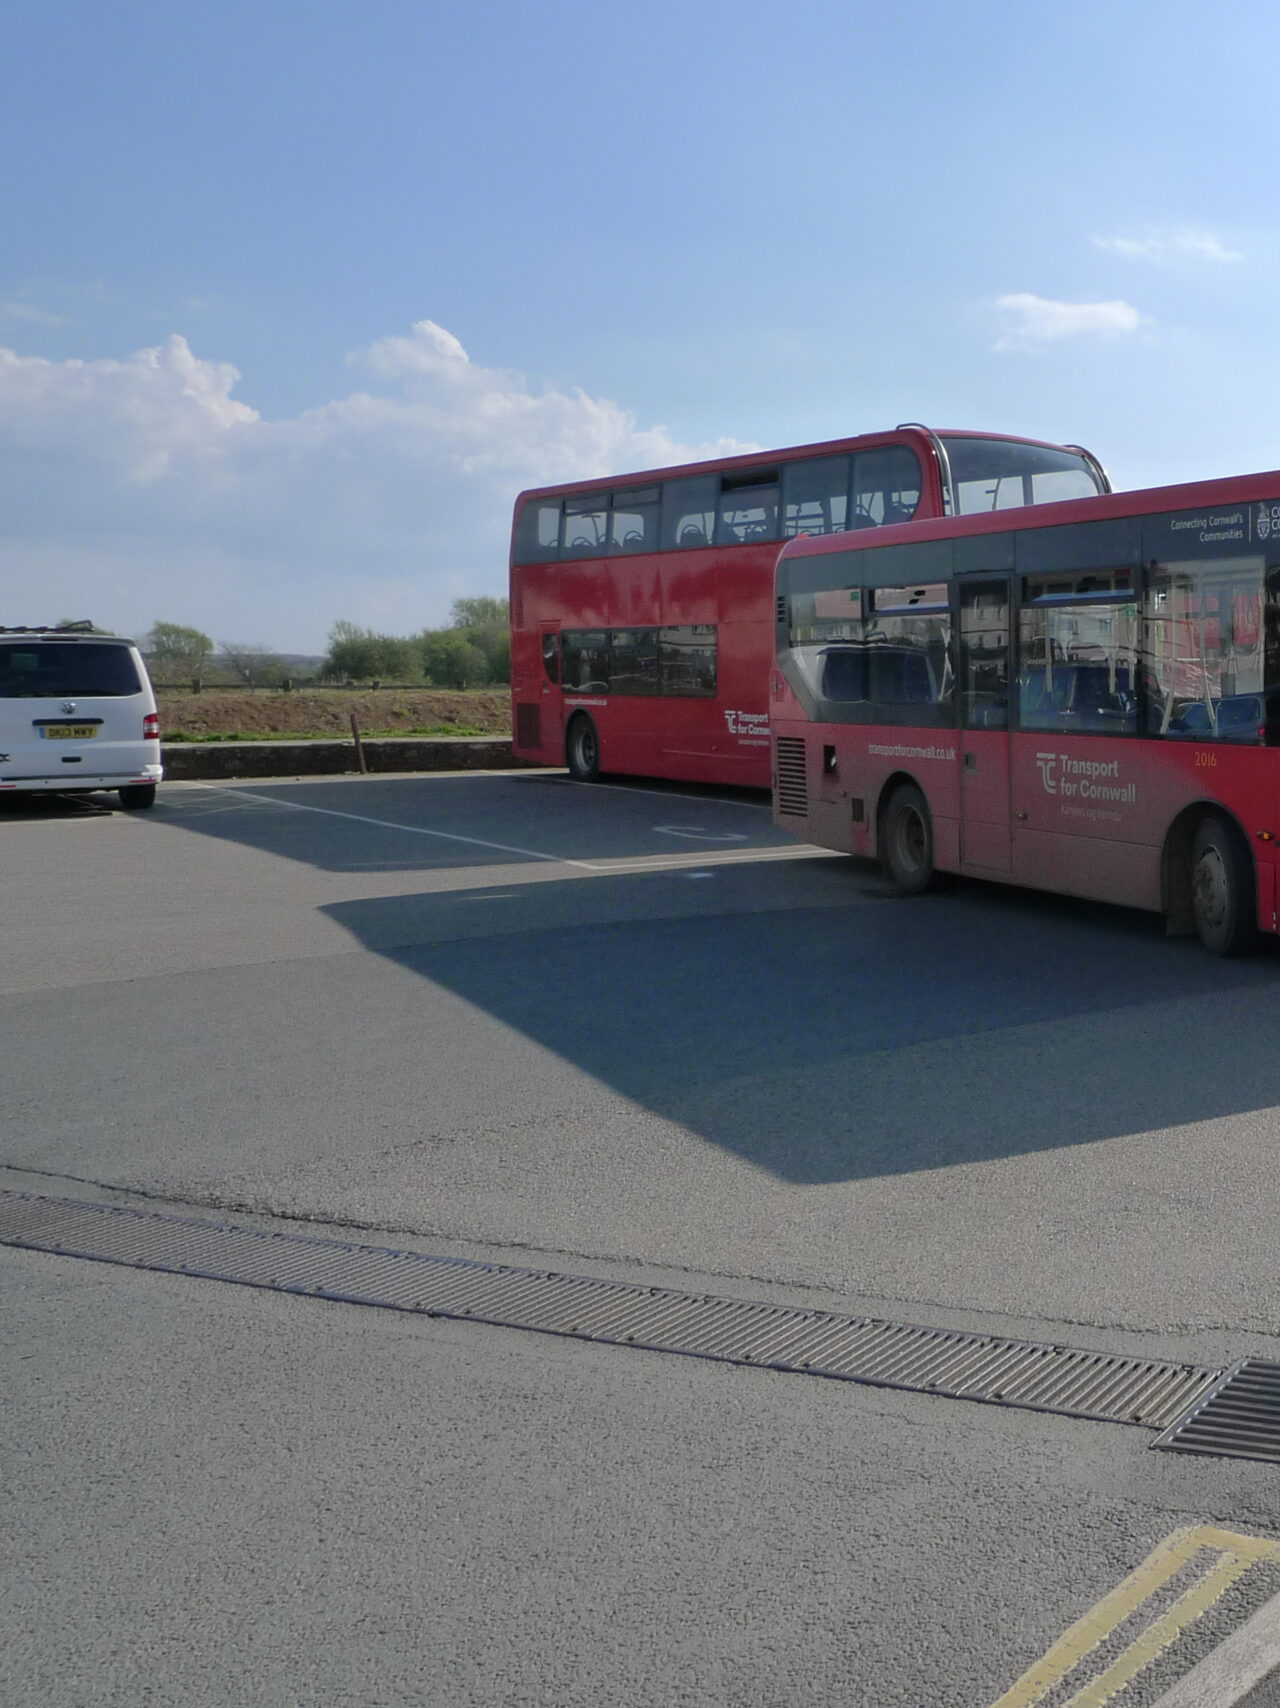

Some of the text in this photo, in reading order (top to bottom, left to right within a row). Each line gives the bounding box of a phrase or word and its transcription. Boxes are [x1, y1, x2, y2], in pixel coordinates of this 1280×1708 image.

[1171, 513, 1243, 530] Connecting Cornwall's
[1200, 529, 1243, 542] Communities
[1060, 755, 1119, 779] Transport
[1195, 752, 1216, 766] 2016
[1060, 777, 1136, 802] for Cornwall
